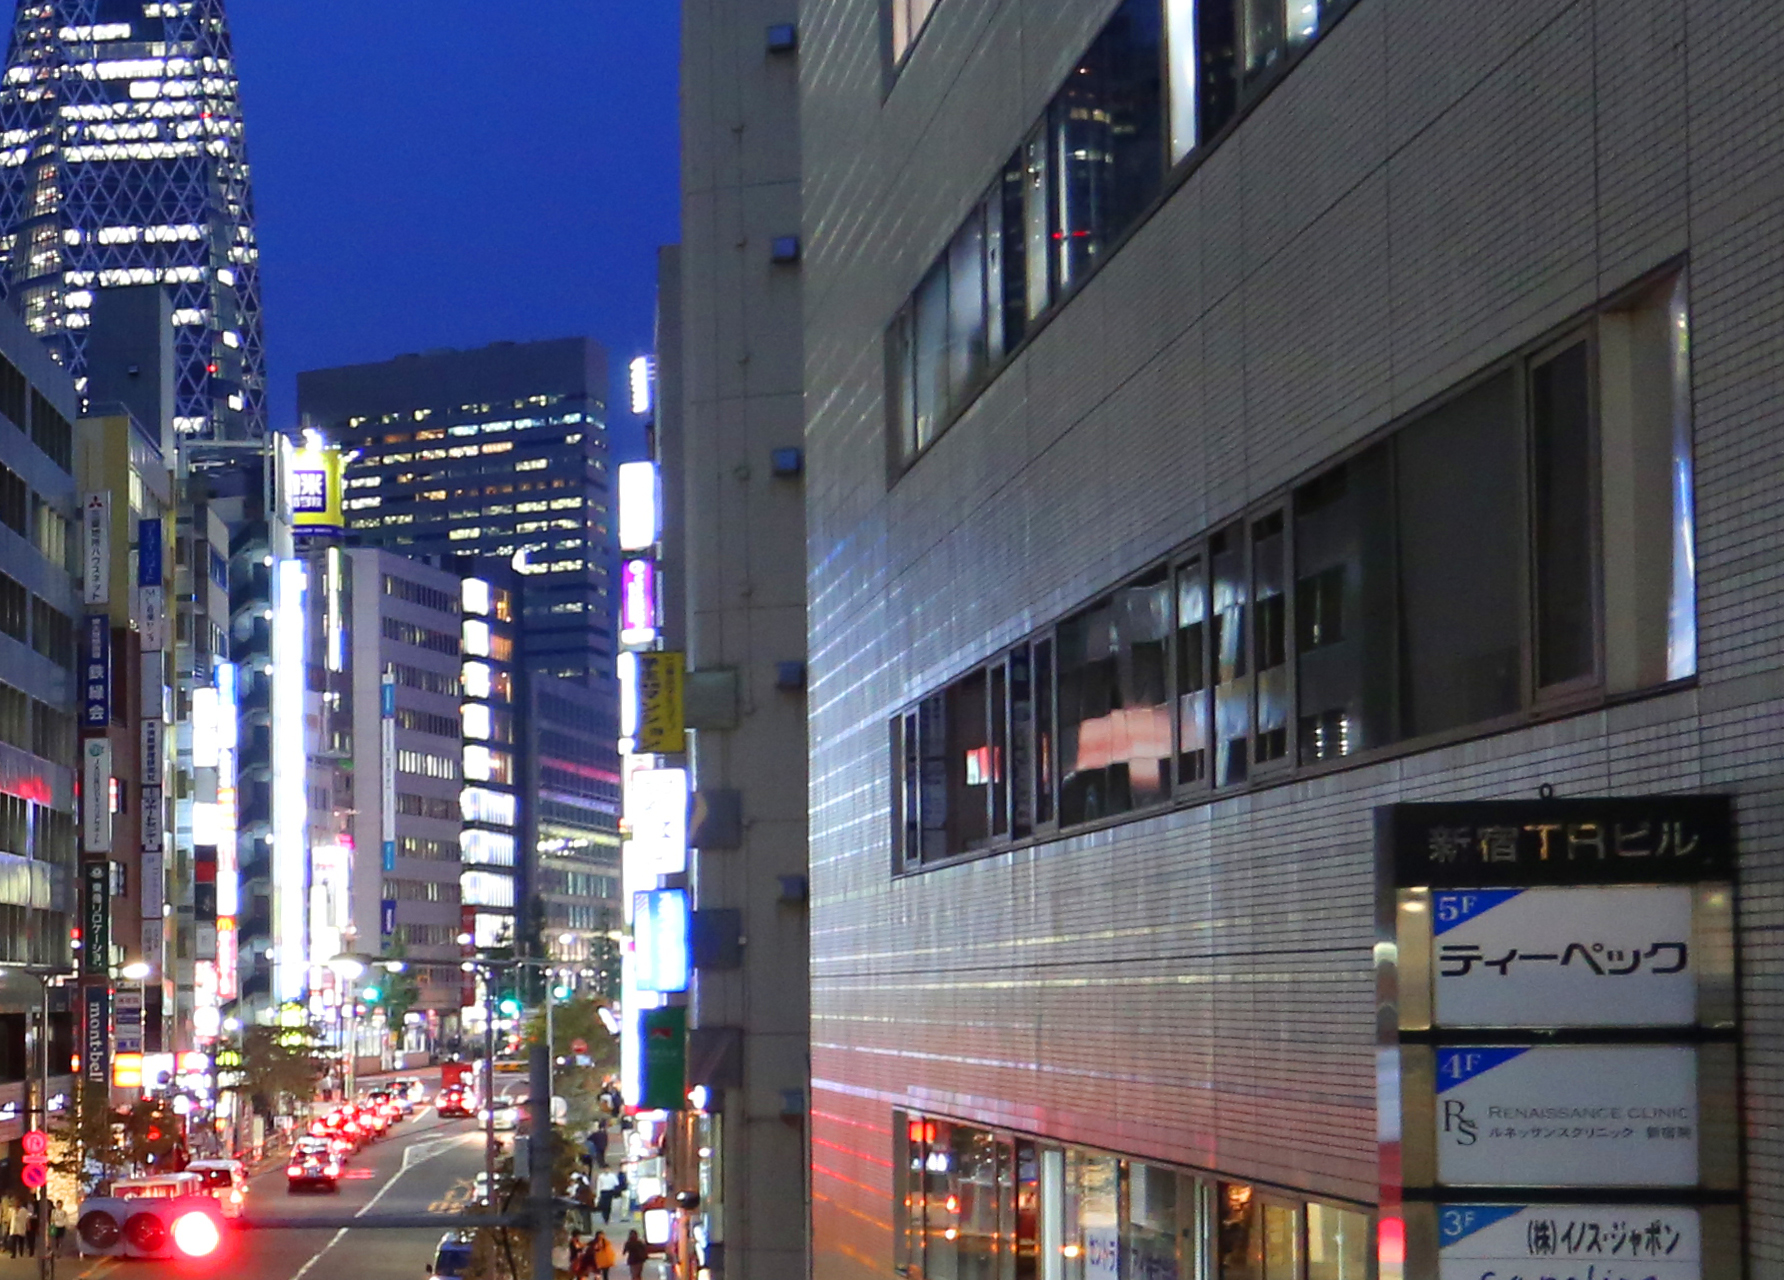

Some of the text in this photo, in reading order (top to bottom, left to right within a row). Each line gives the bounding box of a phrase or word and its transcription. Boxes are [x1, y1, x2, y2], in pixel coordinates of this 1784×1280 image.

[1428, 823, 1698, 863] 新宿TRビル
[1438, 894, 1475, 920] 5F
[1439, 942, 1688, 977] ティーペック
[1441, 1054, 1481, 1081] 4F
[1443, 1210, 1474, 1237] 3F
